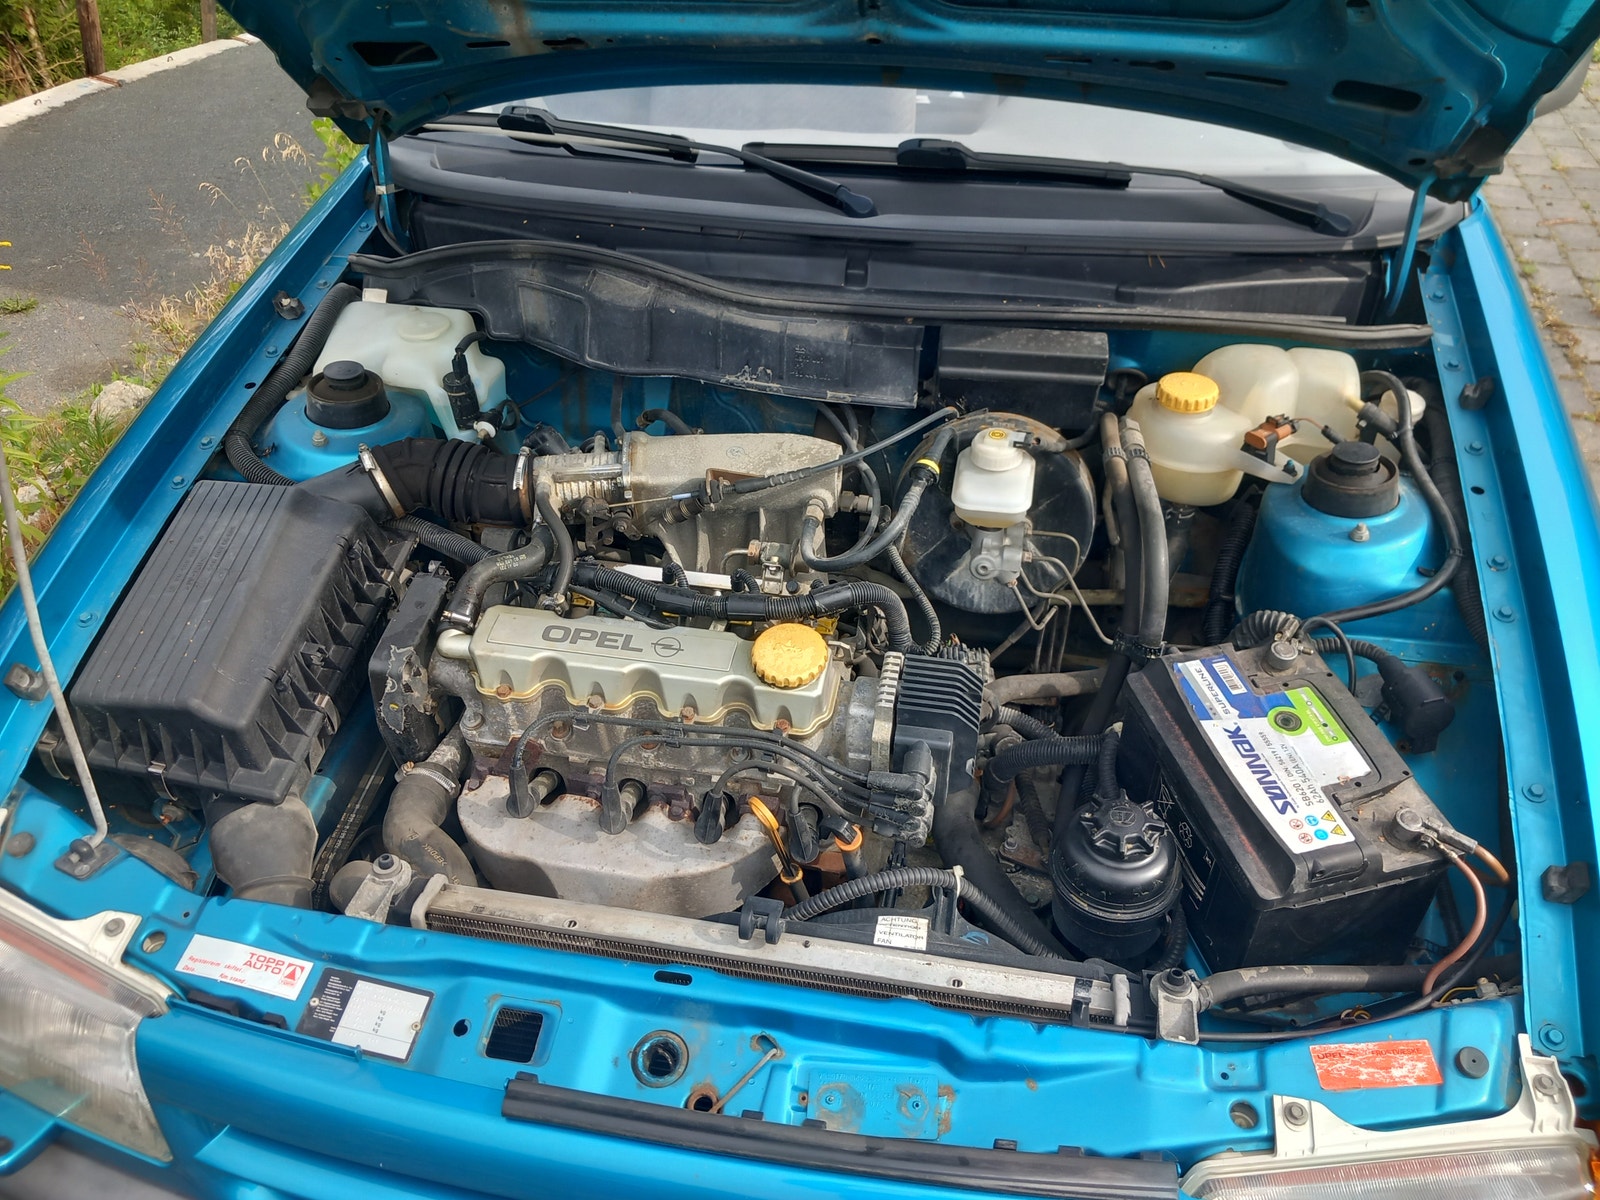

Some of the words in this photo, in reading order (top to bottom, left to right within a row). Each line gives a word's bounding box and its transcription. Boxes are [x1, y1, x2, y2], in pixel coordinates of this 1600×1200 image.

[541, 624, 643, 653] OPEL
[1194, 667, 1231, 715] SUPERLINE
[1293, 764, 1312, 784] 540A
[1292, 783, 1314, 807] SB620
[1306, 783, 1325, 804] 62Ah
[876, 937, 892, 945] FAN
[878, 930, 924, 940] VENTILATOR
[243, 960, 281, 975] AUTO
[249, 952, 285, 967] TOPP
